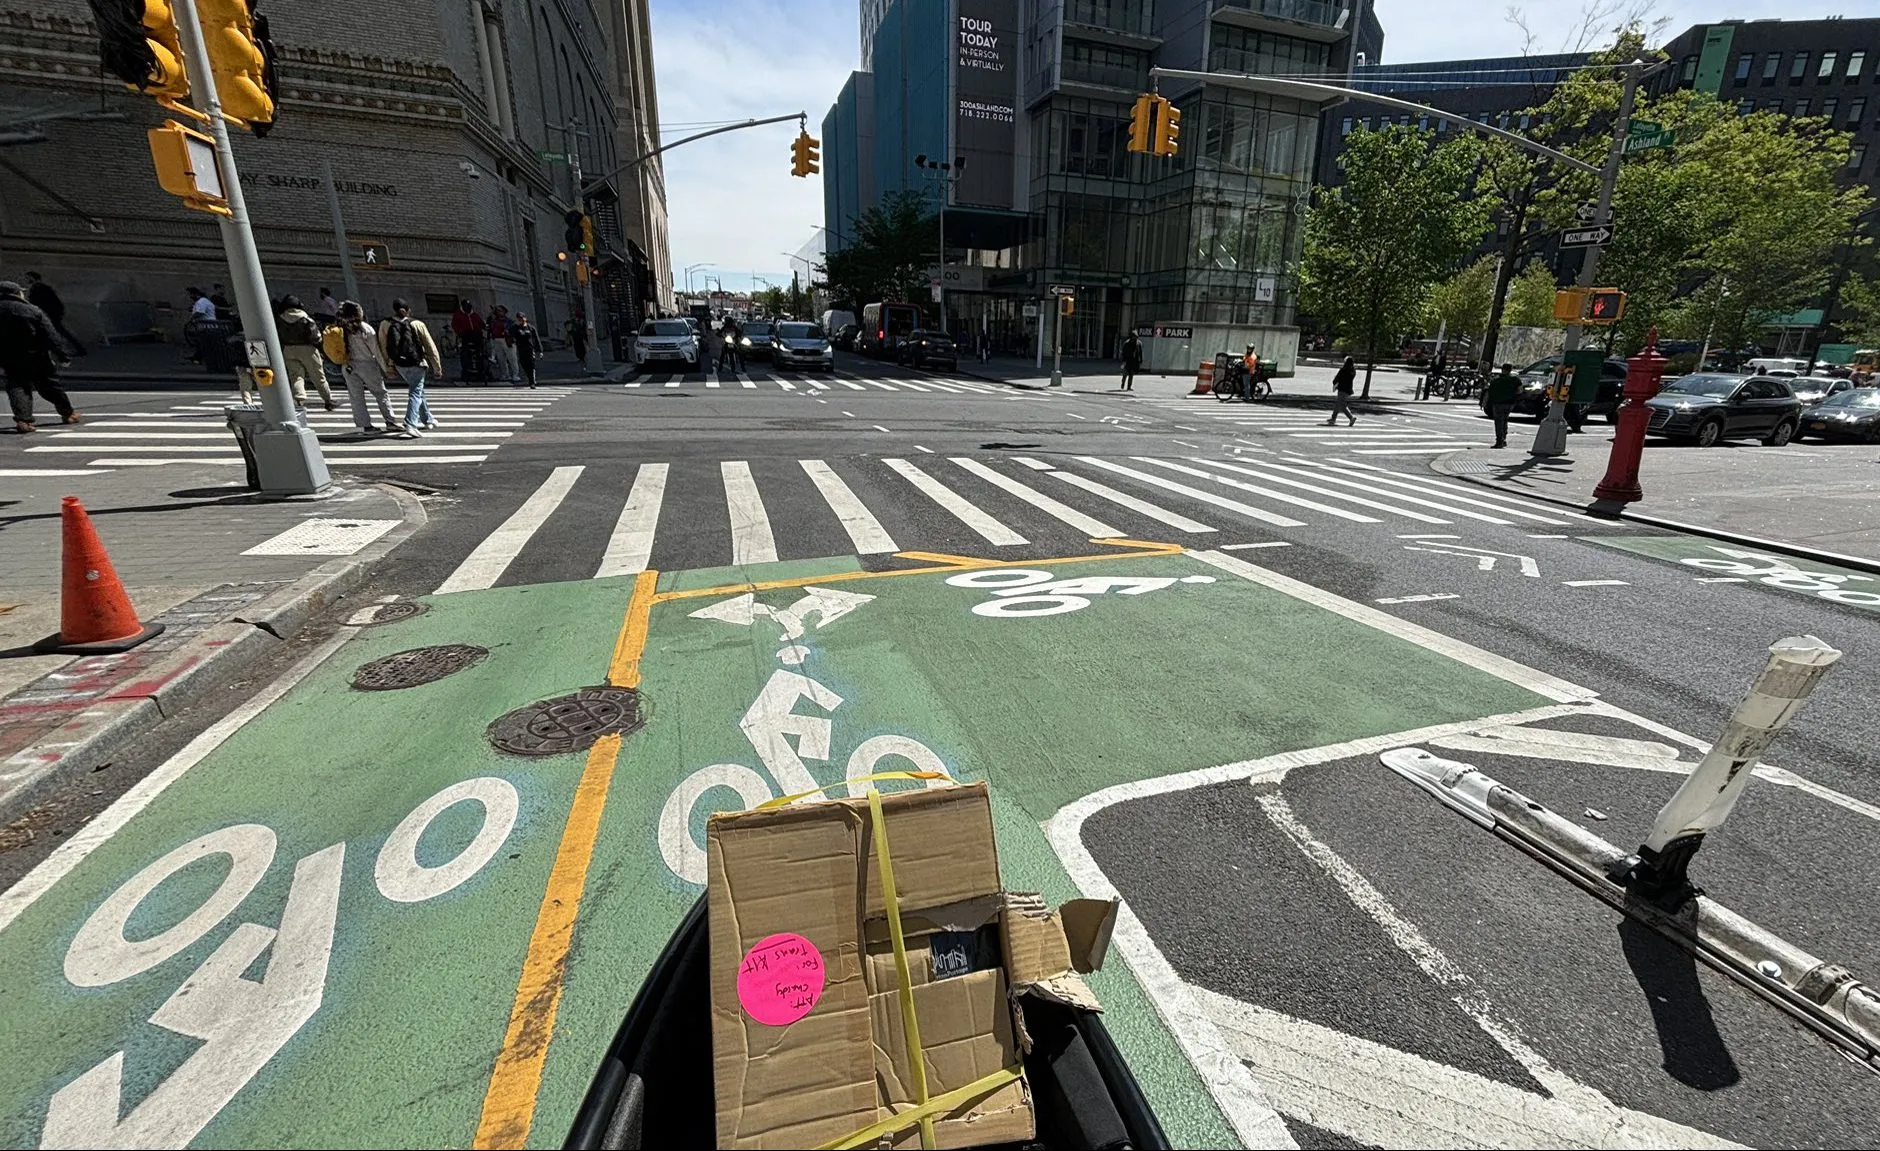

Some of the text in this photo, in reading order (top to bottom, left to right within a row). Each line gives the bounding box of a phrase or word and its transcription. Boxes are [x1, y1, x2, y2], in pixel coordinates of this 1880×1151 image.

[960, 16, 992, 33] TOUR
[960, 31, 998, 49] TODAY
[960, 47, 999, 60] IN-PERSON
[960, 57, 1004, 71] & VIRTUALLY
[1627, 133, 1661, 151] Ashland
[240, 172, 258, 186] AY
[267, 174, 320, 190] SHARP
[1568, 231, 1606, 241] ONE WAY
[1165, 328, 1190, 337] PARK
